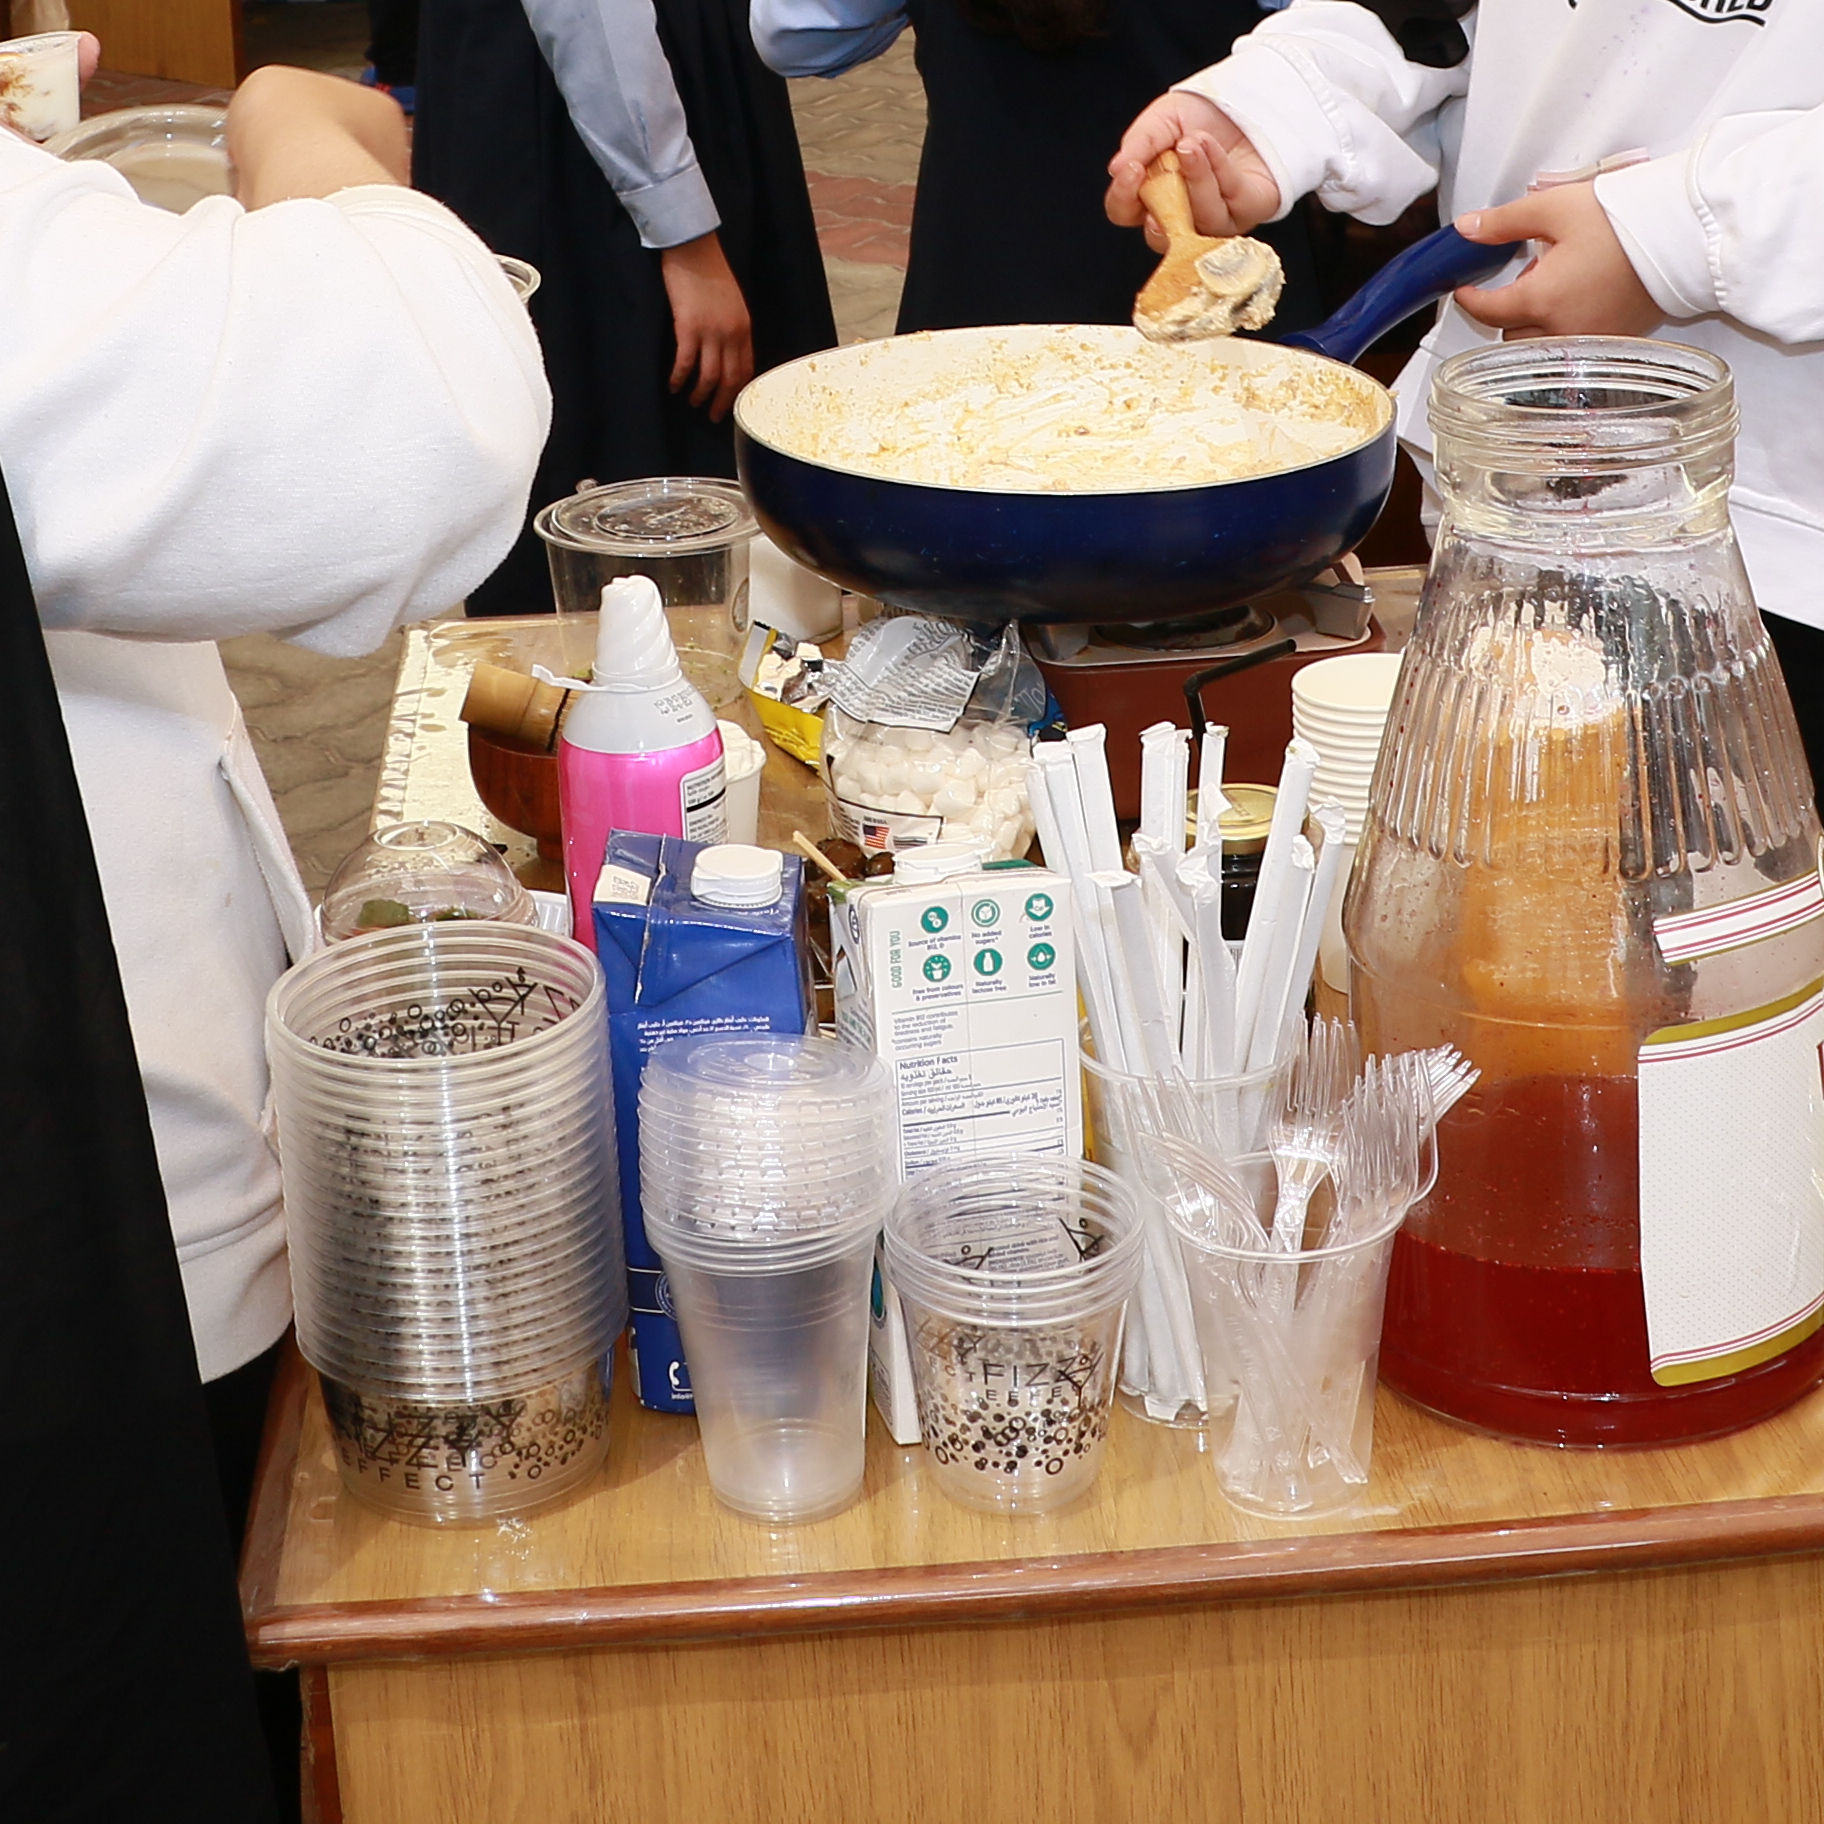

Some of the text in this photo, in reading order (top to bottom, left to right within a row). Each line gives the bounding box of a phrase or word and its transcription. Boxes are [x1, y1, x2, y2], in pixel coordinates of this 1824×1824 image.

[982, 930, 1002, 938] added
[1029, 930, 1052, 939] calories
[908, 939, 928, 948] Source
[890, 931, 902, 988] GOOD FOR YOU
[1029, 973, 1055, 982] Naturally
[976, 979, 1003, 988] Naturally
[927, 986, 940, 994] from
[942, 984, 963, 992] colours
[972, 986, 994, 994] lactose
[900, 1055, 958, 1070] Nutrition Facts
[902, 1108, 922, 1116] Calories
[982, 1352, 1105, 1409] FIZZY
[340, 1446, 485, 1492] EFFECT
